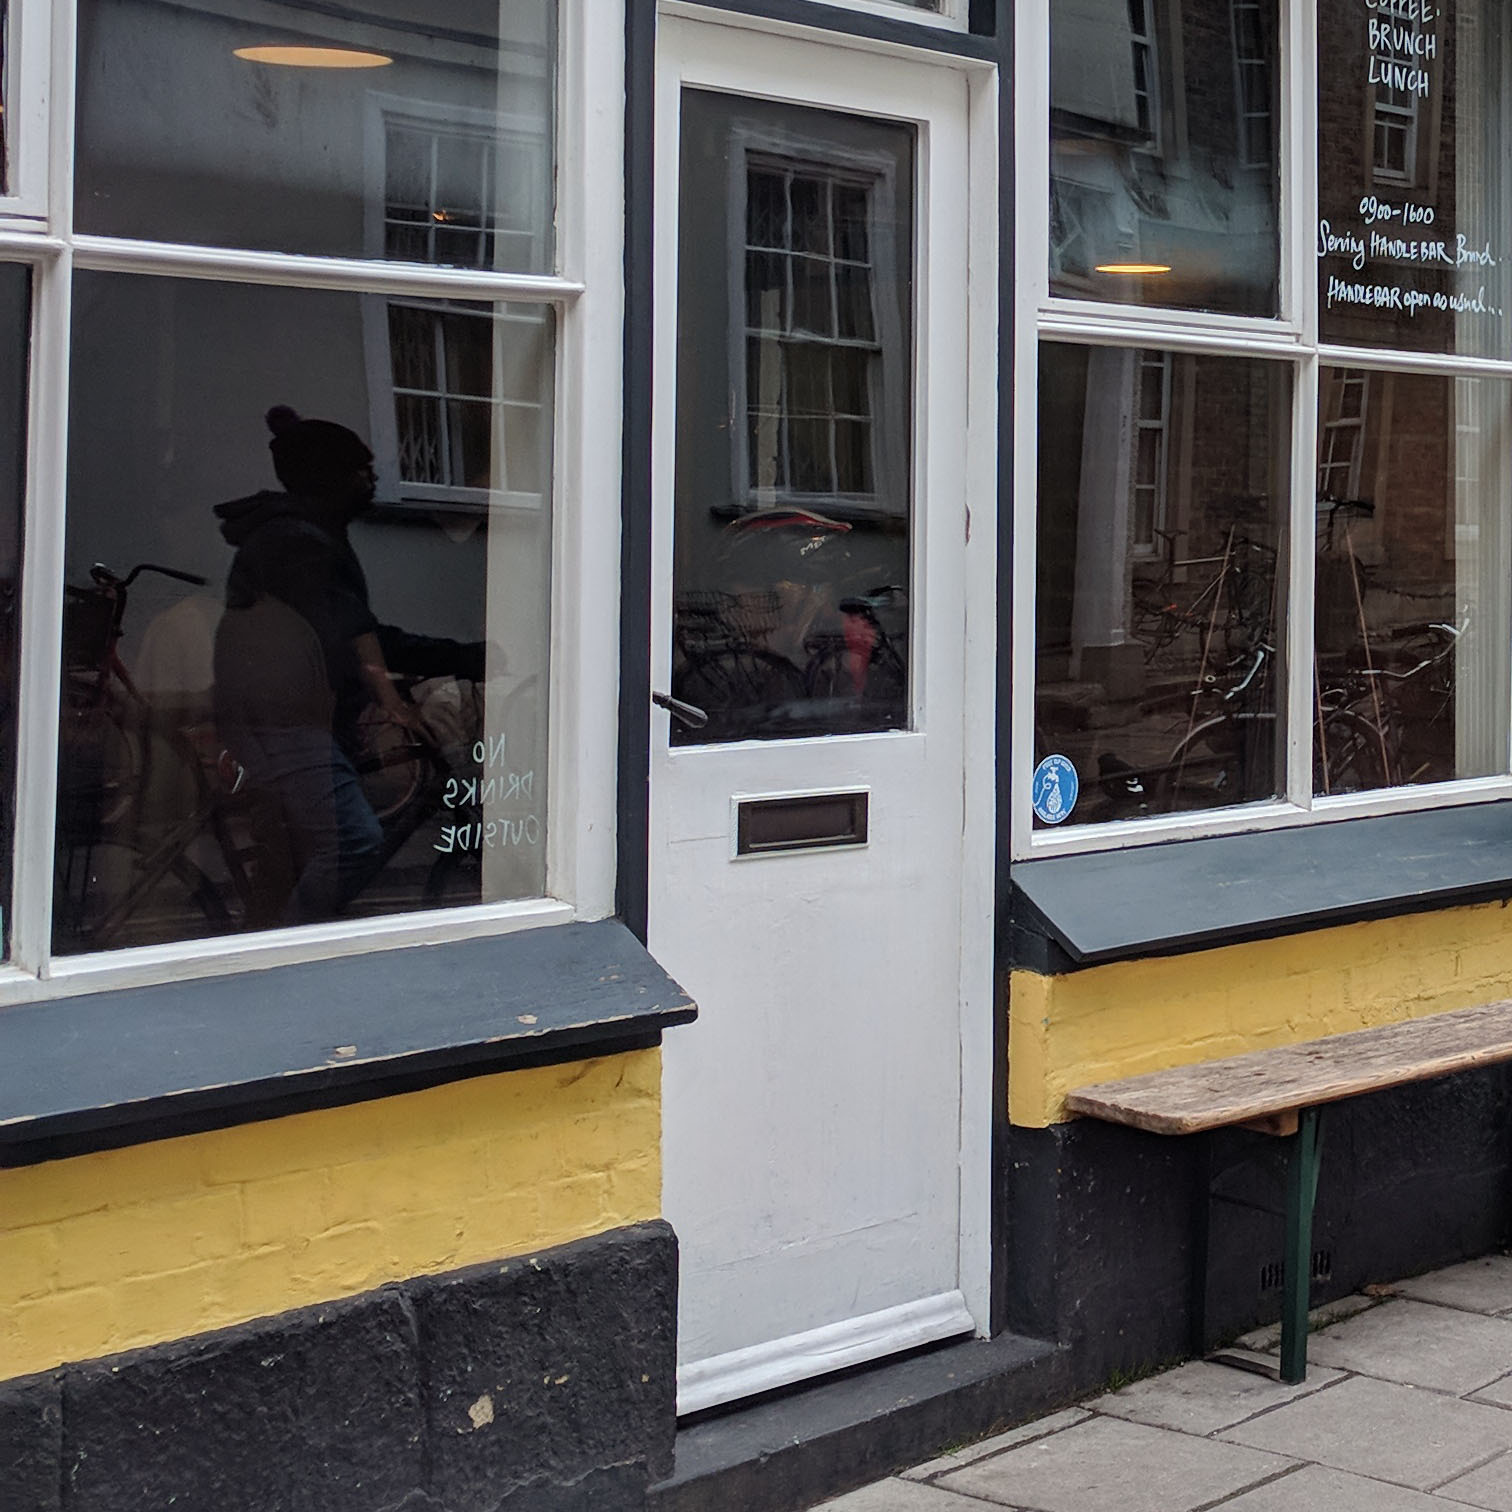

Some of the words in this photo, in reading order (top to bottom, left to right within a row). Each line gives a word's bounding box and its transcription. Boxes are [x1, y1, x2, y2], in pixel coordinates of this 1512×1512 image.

[1368, 18, 1436, 61] BRUNCH
[1368, 55, 1429, 98] LUNCH
[1317, 219, 1366, 271] Serving
[1403, 290, 1431, 318] open
